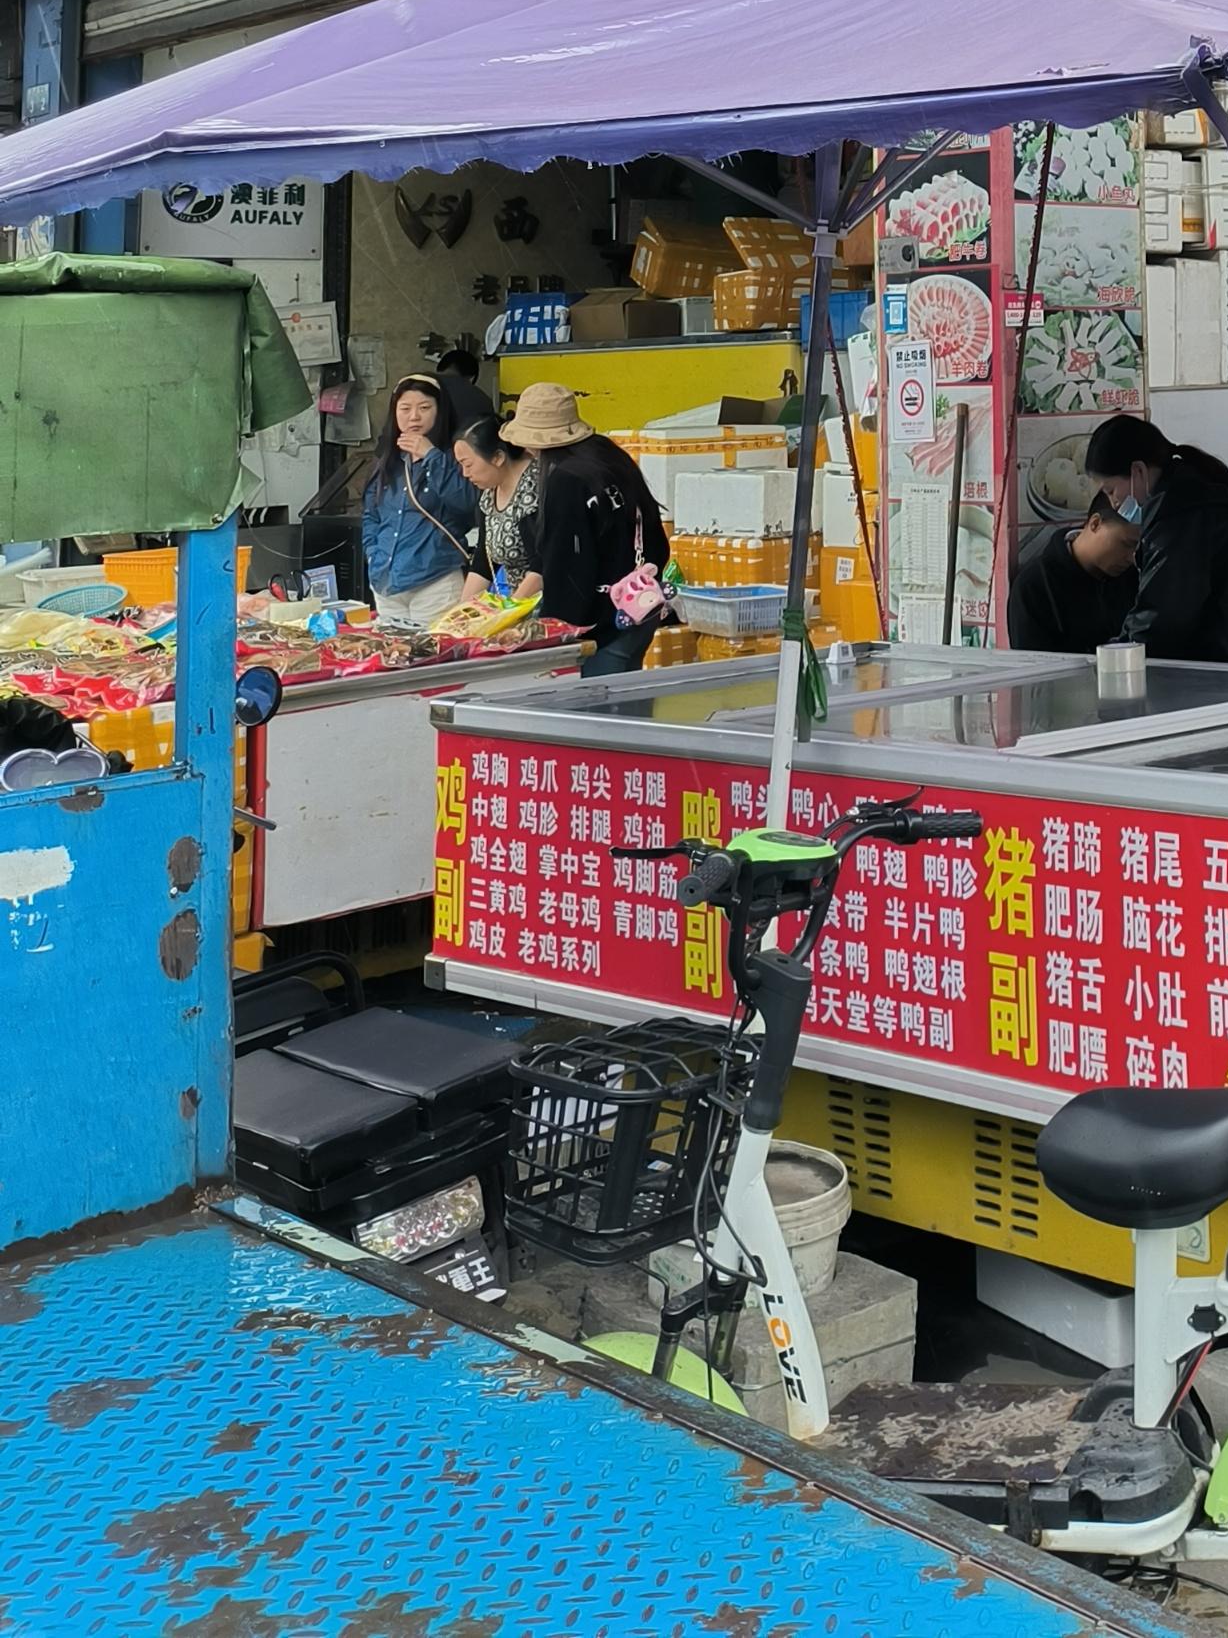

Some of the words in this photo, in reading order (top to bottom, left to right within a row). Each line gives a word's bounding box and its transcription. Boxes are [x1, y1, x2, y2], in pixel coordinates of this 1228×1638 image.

[230, 209, 304, 225] AUFALY
[471, 751, 509, 789] 鸡胸
[520, 755, 559, 794] 鸡爪
[570, 762, 612, 802] 鸡尖
[623, 768, 667, 809] 鸡腿
[791, 787, 841, 828] 鸭心
[471, 792, 509, 830] 中翅
[570, 804, 612, 845] 排腿
[623, 811, 666, 850] 鸡油
[470, 834, 528, 876] 鸡全翅
[538, 843, 601, 888] 掌中宝
[613, 857, 678, 900] 鸡脚筋
[856, 843, 908, 890] 鸭翅
[1042, 816, 1102, 878] 猪蹄
[1120, 826, 1184, 889] 猪尾
[469, 877, 528, 920] 三黄鸡
[538, 886, 601, 933] 老母鸡
[613, 899, 680, 947] 青脚鸡
[884, 896, 966, 951] 半片鸭
[1044, 883, 1104, 945] 肥肠
[1122, 895, 1186, 959] 脑花
[469, 919, 507, 959] 鸡皮
[518, 928, 601, 977] 老鸡系列
[884, 947, 967, 1002] 鸭翅根
[984, 826, 1039, 1067] 猪副
[1045, 950, 1106, 1015] 猪舌
[1124, 964, 1189, 1029] 小肚
[1048, 1018, 1109, 1084] 肥膘
[1125, 1034, 1189, 1090] 碎肉
